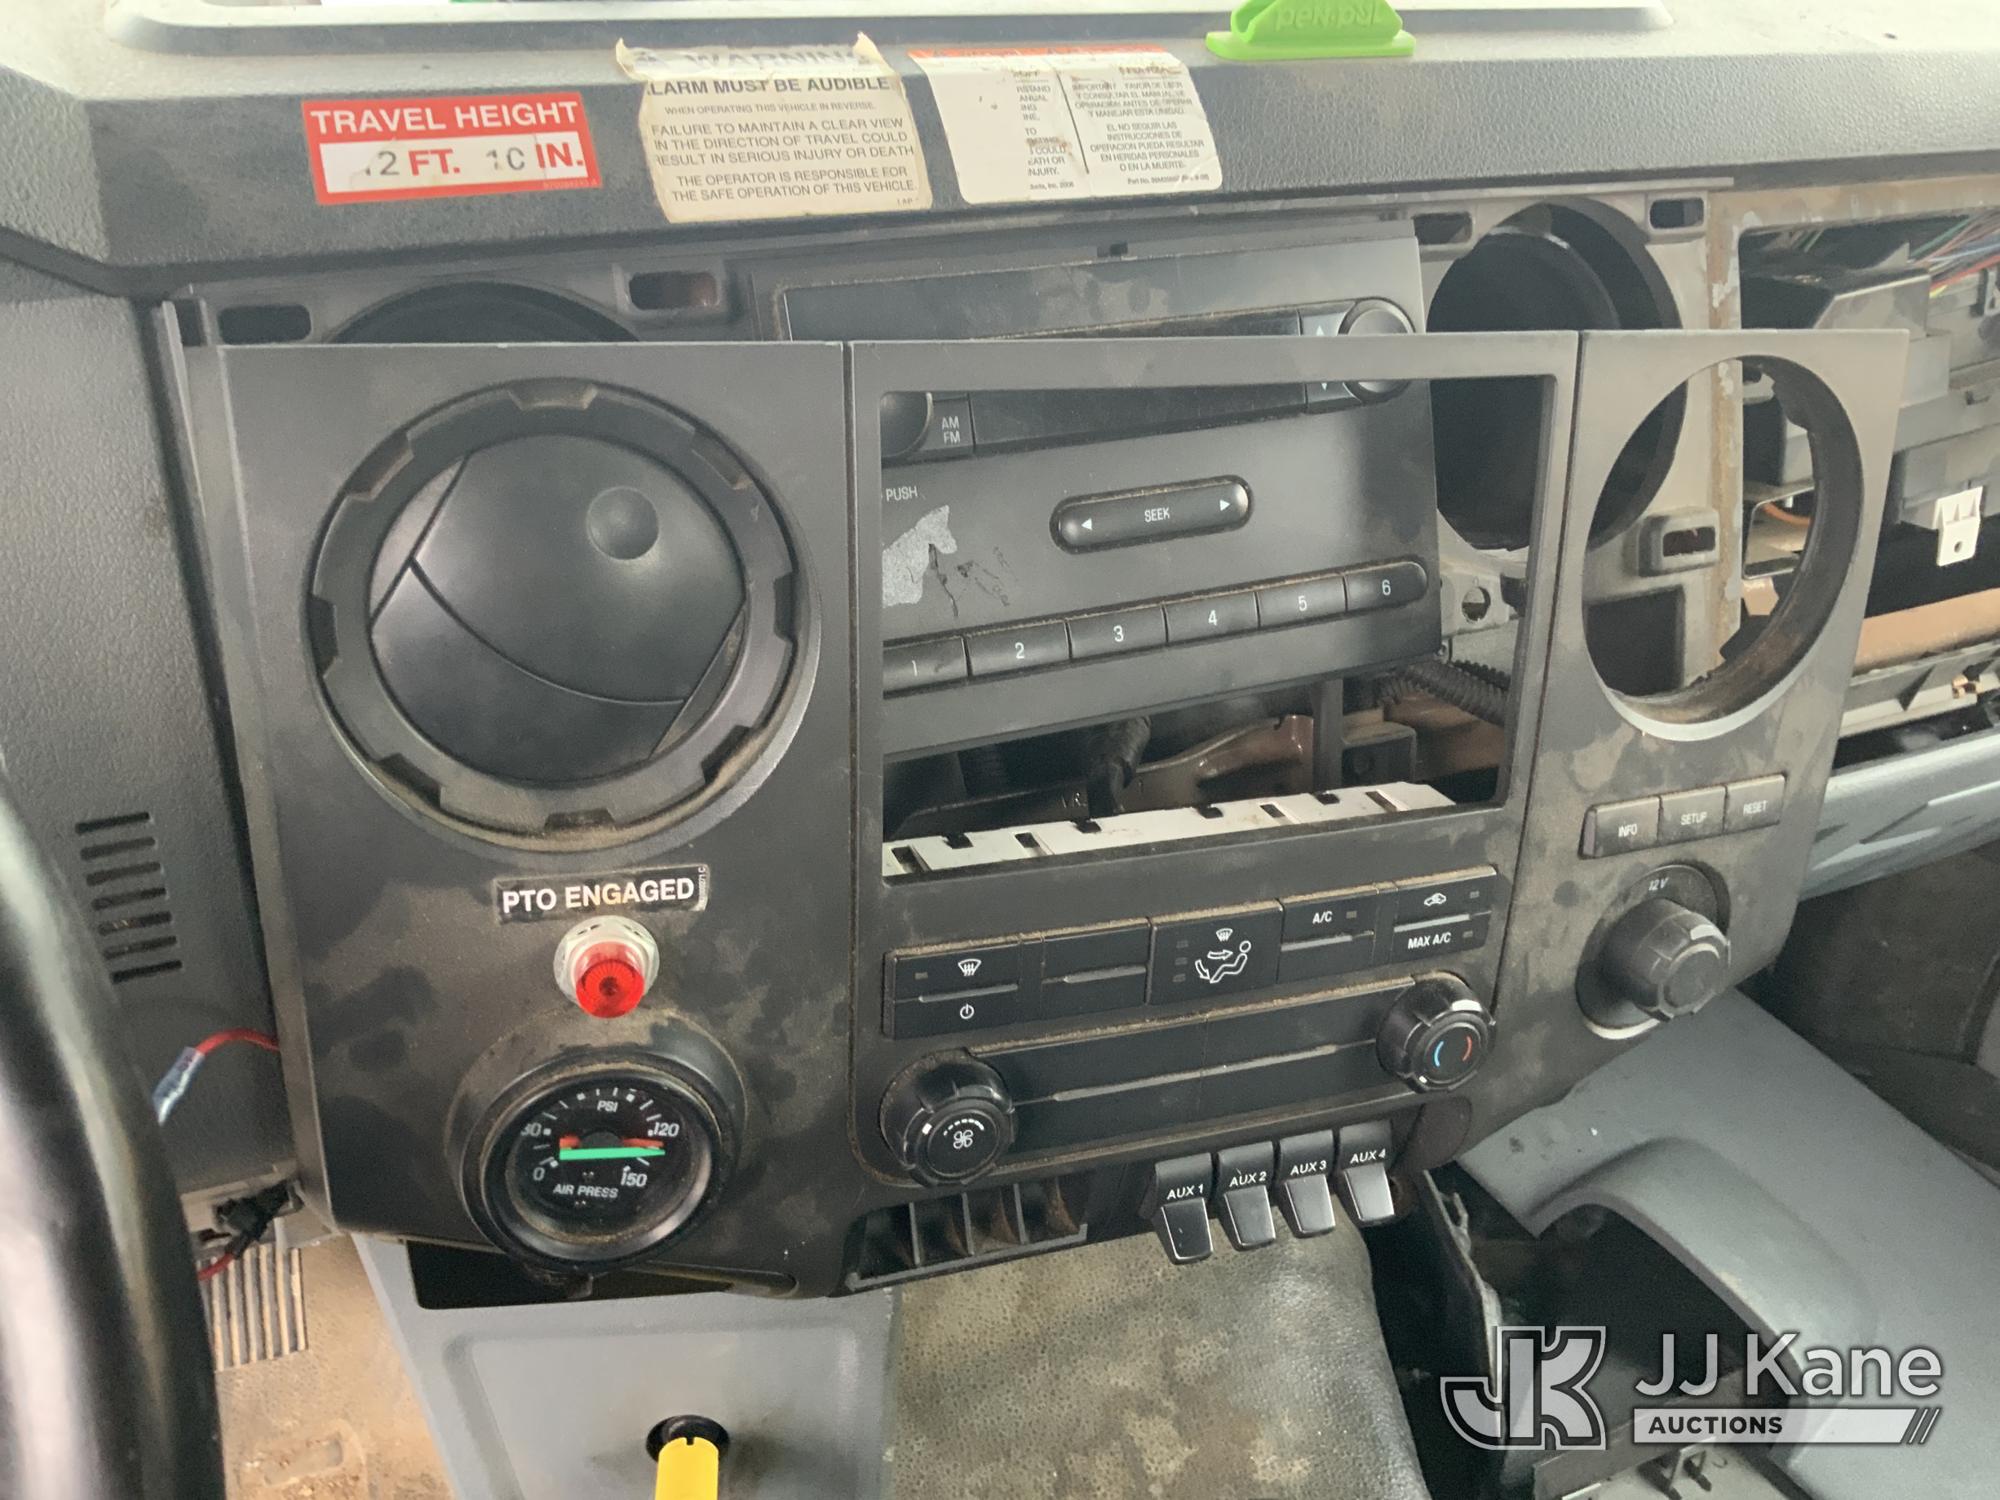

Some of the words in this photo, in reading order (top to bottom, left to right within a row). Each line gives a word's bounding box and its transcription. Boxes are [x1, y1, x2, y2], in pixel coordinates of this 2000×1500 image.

[714, 80, 769, 94] MUST
[774, 78, 801, 92] BE
[808, 77, 890, 91] AUDIBLE
[665, 106, 695, 114] WHEN
[697, 104, 752, 114] OPERATING
[756, 104, 776, 112] THIS
[779, 103, 818, 112] VEHICLE
[820, 102, 829, 110] IN
[310, 108, 446, 134] TRAVEL
[454, 102, 578, 128] HEIGHT
[651, 124, 712, 136] FAILURE
[715, 123, 734, 134] TO
[738, 120, 805, 133] MAINTAIN
[809, 121, 818, 130] A
[822, 119, 868, 130] CLEAR
[870, 118, 902, 128] VIEW
[1025, 128, 1037, 136] TO
[654, 140, 668, 150] IN
[672, 138, 700, 150] THE
[704, 136, 780, 149] DIRECTION
[783, 135, 801, 146] OF
[806, 133, 858, 144] TRAVEL
[862, 132, 908, 143] COULD
[1138, 142, 1165, 150] PUEDA
[1166, 140, 1204, 148] RESULTAR
[365, 150, 400, 176] 2
[408, 148, 460, 176] FT.
[535, 142, 584, 168] IN.
[711, 152, 725, 164] IN
[728, 150, 790, 164] SERIOUS
[794, 148, 842, 160] INJURY
[846, 147, 866, 158] OR
[870, 146, 914, 158] DEATH
[1052, 156, 1065, 164] OR
[1101, 154, 1112, 162] EN
[1114, 152, 1147, 161] HERIDAS
[1149, 150, 1199, 160] PERSONALES
[1120, 164, 1126, 172] O
[1128, 163, 1139, 171] EN
[1141, 162, 1151, 170] LA
[676, 175, 702, 186] THE
[706, 172, 776, 185] OPERATOR
[780, 172, 791, 182] IS
[794, 168, 879, 181] RESPONSIBLE
[882, 166, 908, 177] FOR
[672, 190, 699, 202] THE
[702, 188, 734, 200] SAFE
[738, 185, 810, 199] OPERATION
[813, 183, 830, 195] OF
[833, 182, 862, 194] THIS
[941, 416, 960, 430] AM
[944, 432, 961, 444] FM
[886, 486, 918, 502] PUSH
[1144, 508, 1170, 523] SEEK
[1381, 579, 1391, 596] 6
[1298, 594, 1308, 612] 5
[1207, 609, 1218, 627] 4
[1113, 626, 1124, 643] 3
[1014, 642, 1025, 660] 2
[912, 660, 918, 676] 1
[1743, 800, 1768, 814] RESET
[1680, 812, 1708, 826] SETUP
[1618, 824, 1638, 837] INFO
[502, 888, 557, 914] PTO
[565, 878, 694, 908] ENGAGED
[1312, 911, 1333, 925] A/C
[1408, 935, 1430, 950] MAX
[1432, 932, 1452, 945] A/C
[597, 1100, 618, 1113] PSI
[653, 1122, 680, 1137] 120
[1350, 1151, 1375, 1164] AUX
[1376, 1148, 1386, 1160] 4
[533, 1167, 545, 1181] 0
[1290, 1162, 1316, 1176] AUX
[1318, 1160, 1327, 1172] 3
[620, 1170, 648, 1188] 150
[1229, 1173, 1257, 1188] AUX
[1258, 1171, 1267, 1183] 2
[553, 1183, 575, 1196] AIR
[577, 1185, 619, 1198] PRESS
[1166, 1186, 1195, 1200] AUX
[1198, 1184, 1204, 1194] 1
